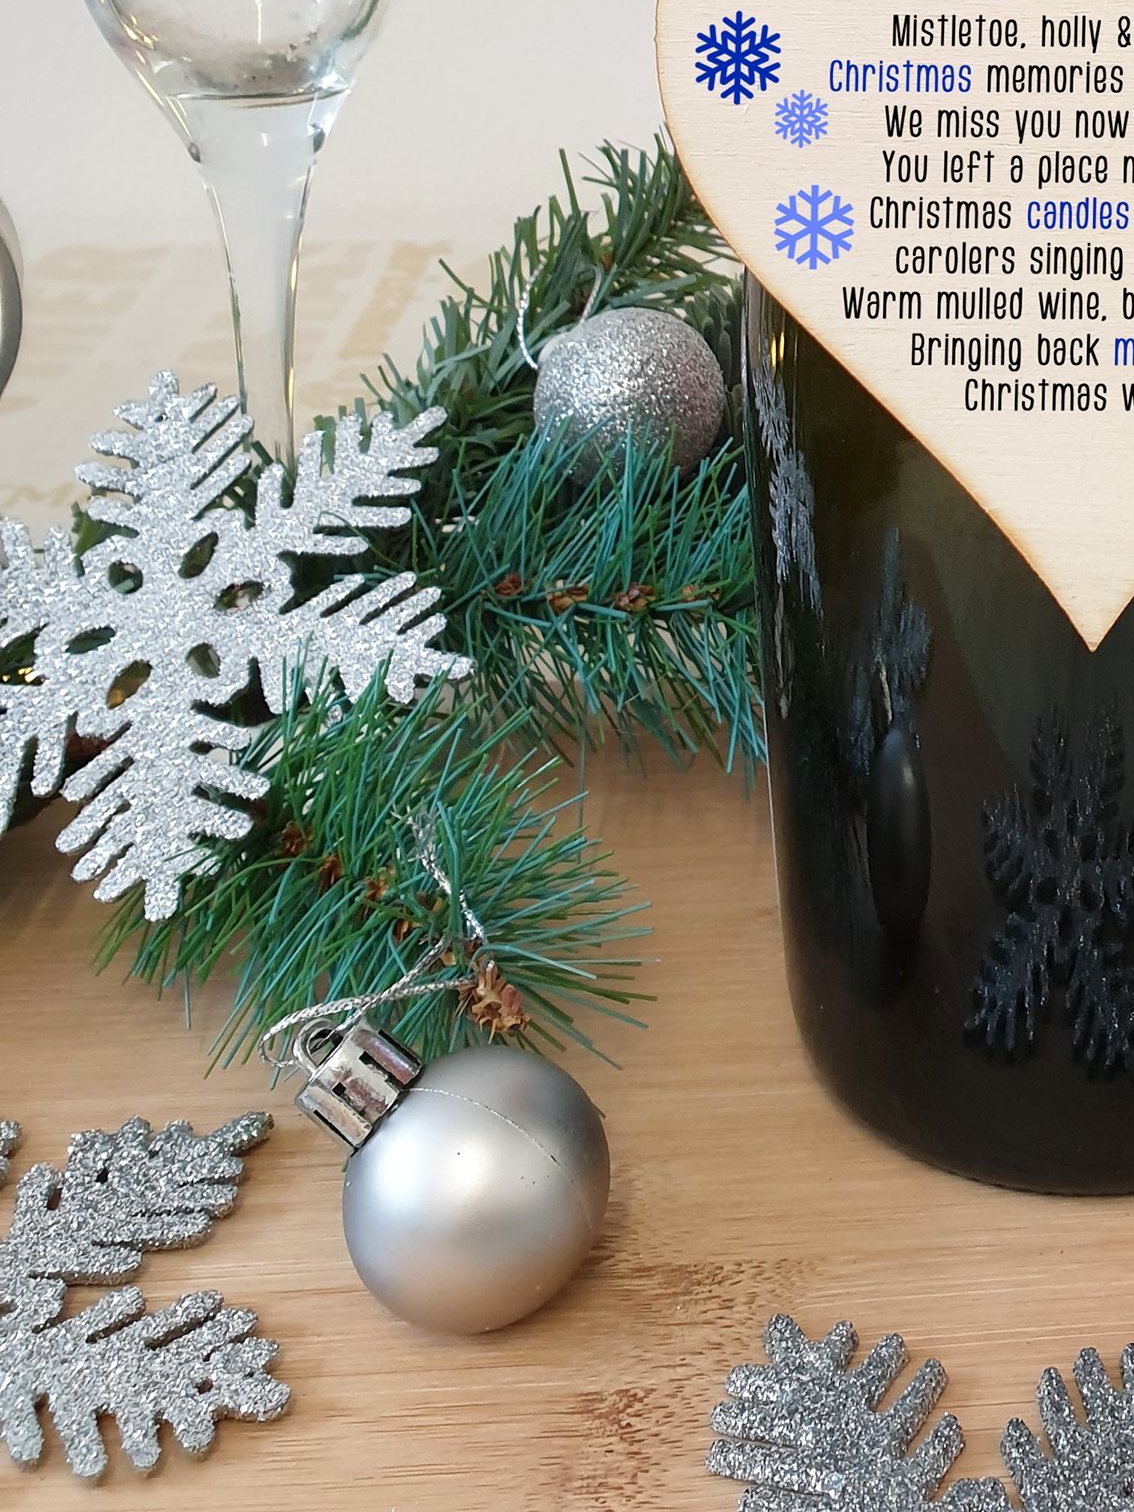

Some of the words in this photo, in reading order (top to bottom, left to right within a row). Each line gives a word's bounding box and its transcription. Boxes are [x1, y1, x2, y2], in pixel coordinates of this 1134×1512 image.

[892, 14, 1026, 49] Mistletoe,
[1041, 14, 1102, 54] holly
[1117, 15, 1132, 48] &
[829, 59, 972, 93] Christmas
[987, 61, 1124, 94] memories
[884, 104, 922, 138] We
[937, 105, 1000, 138] miss
[1015, 109, 1061, 145] you
[1075, 110, 1130, 139] now
[882, 150, 928, 183] You
[943, 150, 995, 183] left
[1010, 155, 1023, 184] a
[1038, 150, 1108, 190] place
[870, 196, 1012, 229] Christmas
[1027, 197, 1129, 230] candles
[895, 241, 1015, 275] carolers
[1030, 242, 1124, 281] singing
[842, 286, 922, 320] Warm
[936, 287, 1023, 320] mulled
[1038, 287, 1107, 322] wine,
[911, 332, 1022, 372] Bringing
[1037, 333, 1100, 366] back
[964, 378, 1107, 412] Christmas
